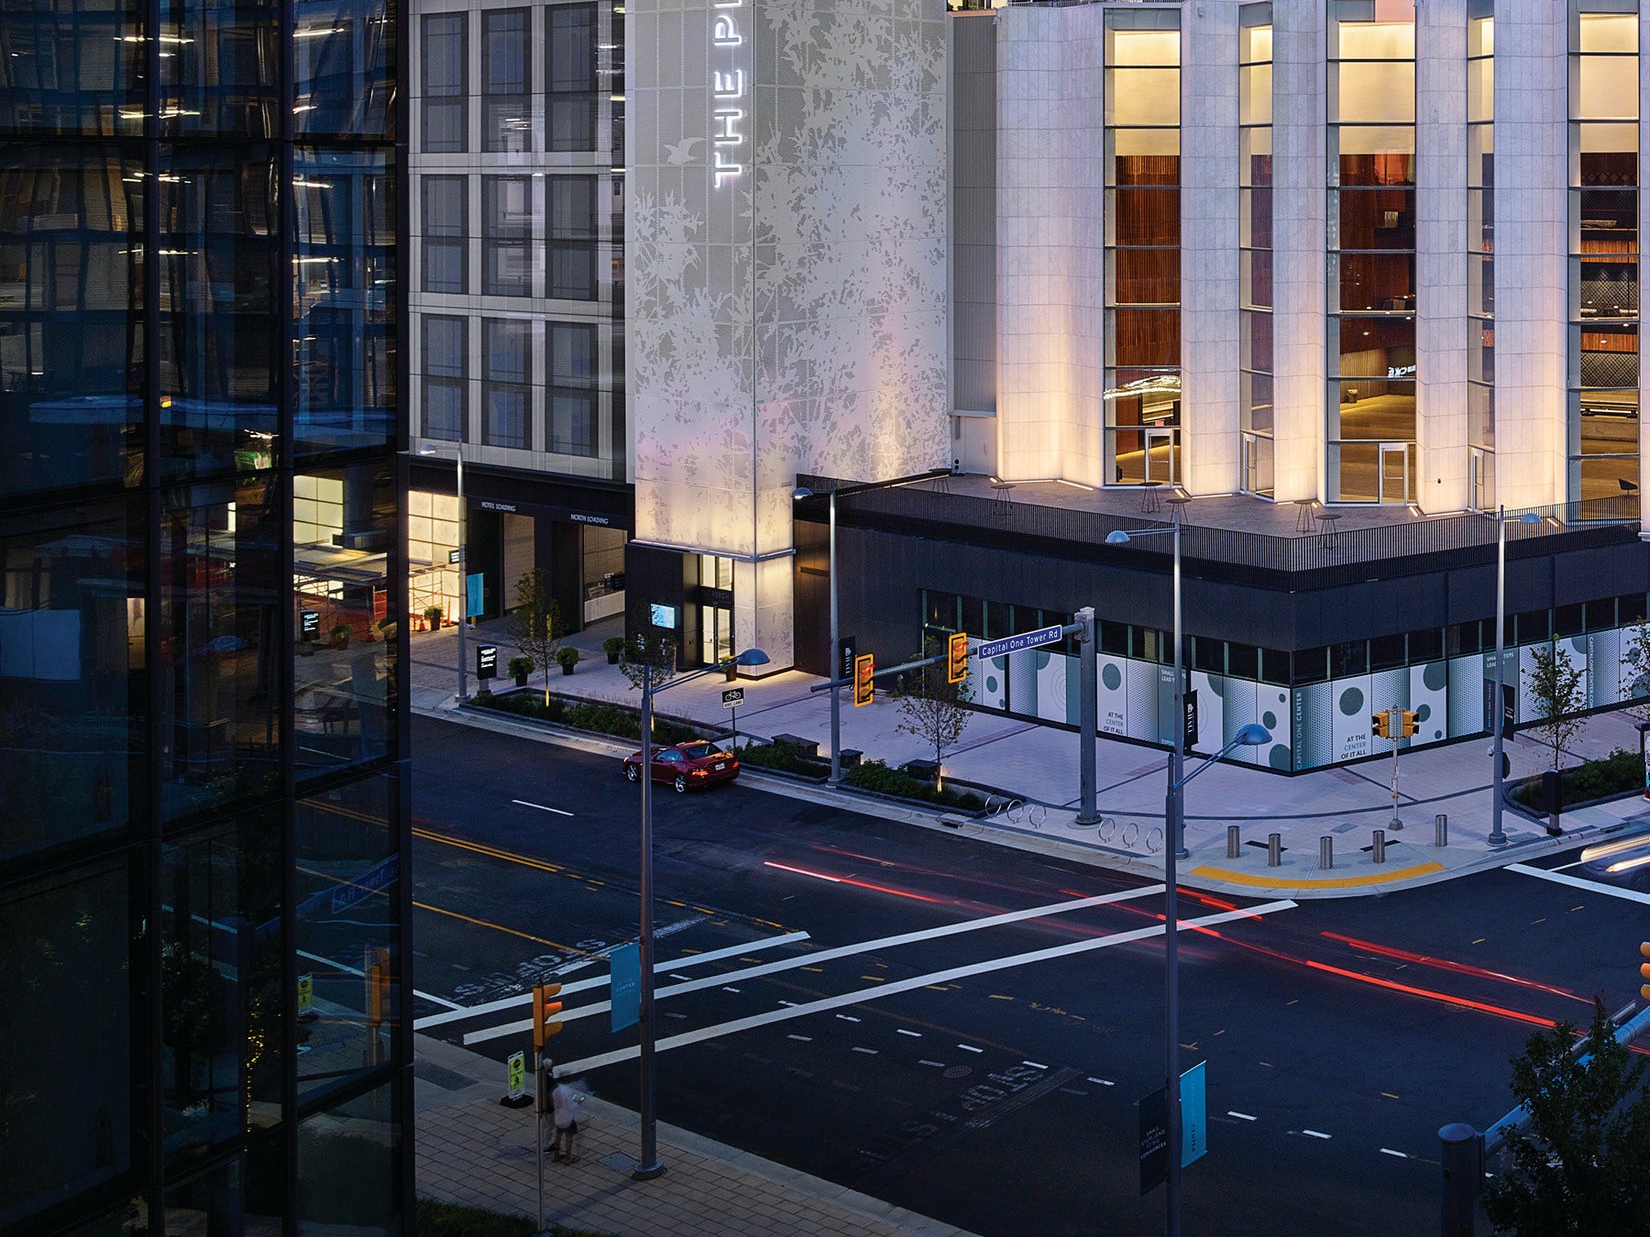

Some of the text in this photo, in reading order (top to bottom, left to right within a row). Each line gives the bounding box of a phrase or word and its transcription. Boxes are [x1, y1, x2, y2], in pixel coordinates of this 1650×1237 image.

[714, 69, 743, 189] THE
[982, 630, 1058, 656] Capital One Tower Rd
[1106, 718, 1124, 726] CENTER
[1355, 733, 1366, 741] THE
[1344, 743, 1366, 751] CENTER
